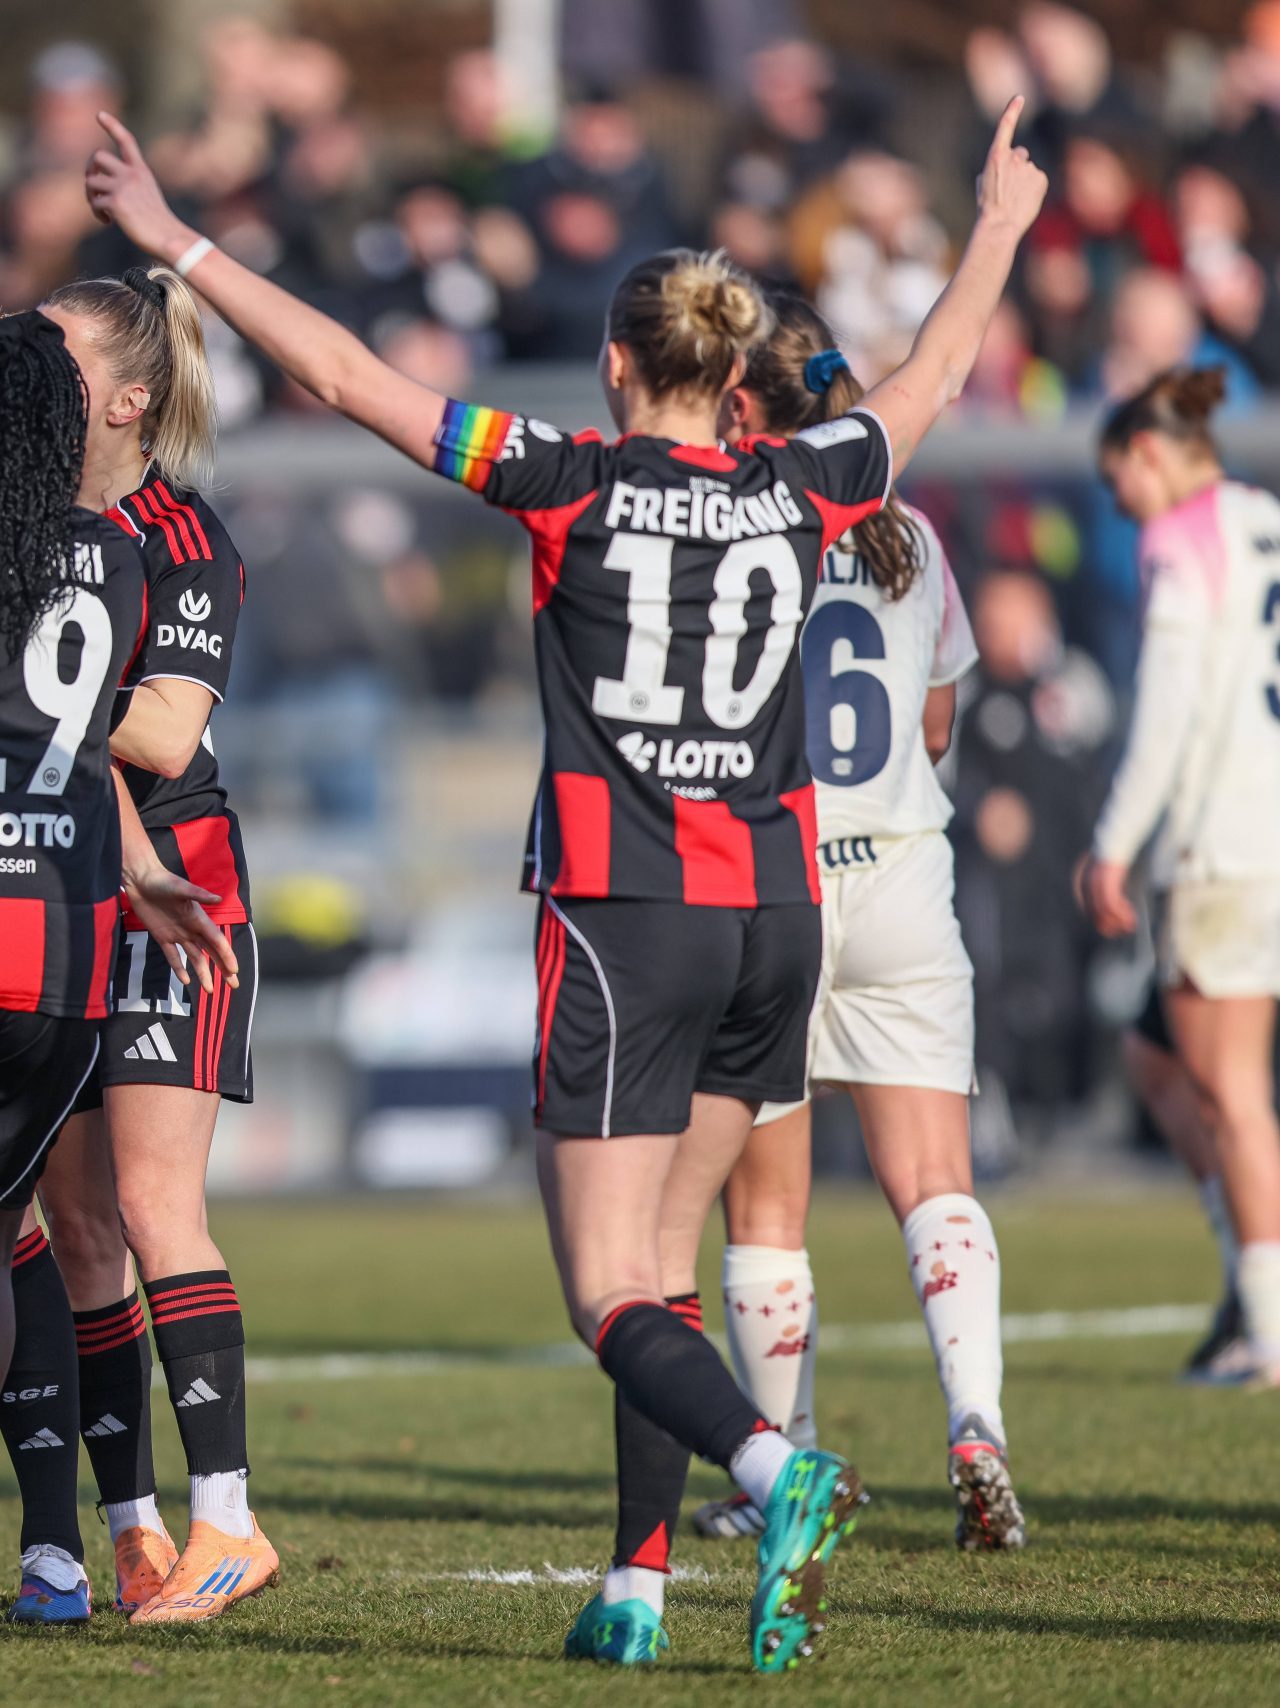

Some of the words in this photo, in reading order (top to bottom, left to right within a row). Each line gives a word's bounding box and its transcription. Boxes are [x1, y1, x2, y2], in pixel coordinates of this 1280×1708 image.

[604, 480, 804, 541] FREIGANG
[156, 624, 223, 660] DVAG
[592, 531, 804, 729] 10
[799, 600, 891, 787] 6
[657, 738, 755, 779] LOTTO
[118, 930, 191, 1017] 11
[2, 1384, 59, 1403] SGE
[147, 1597, 216, 1615] F50
